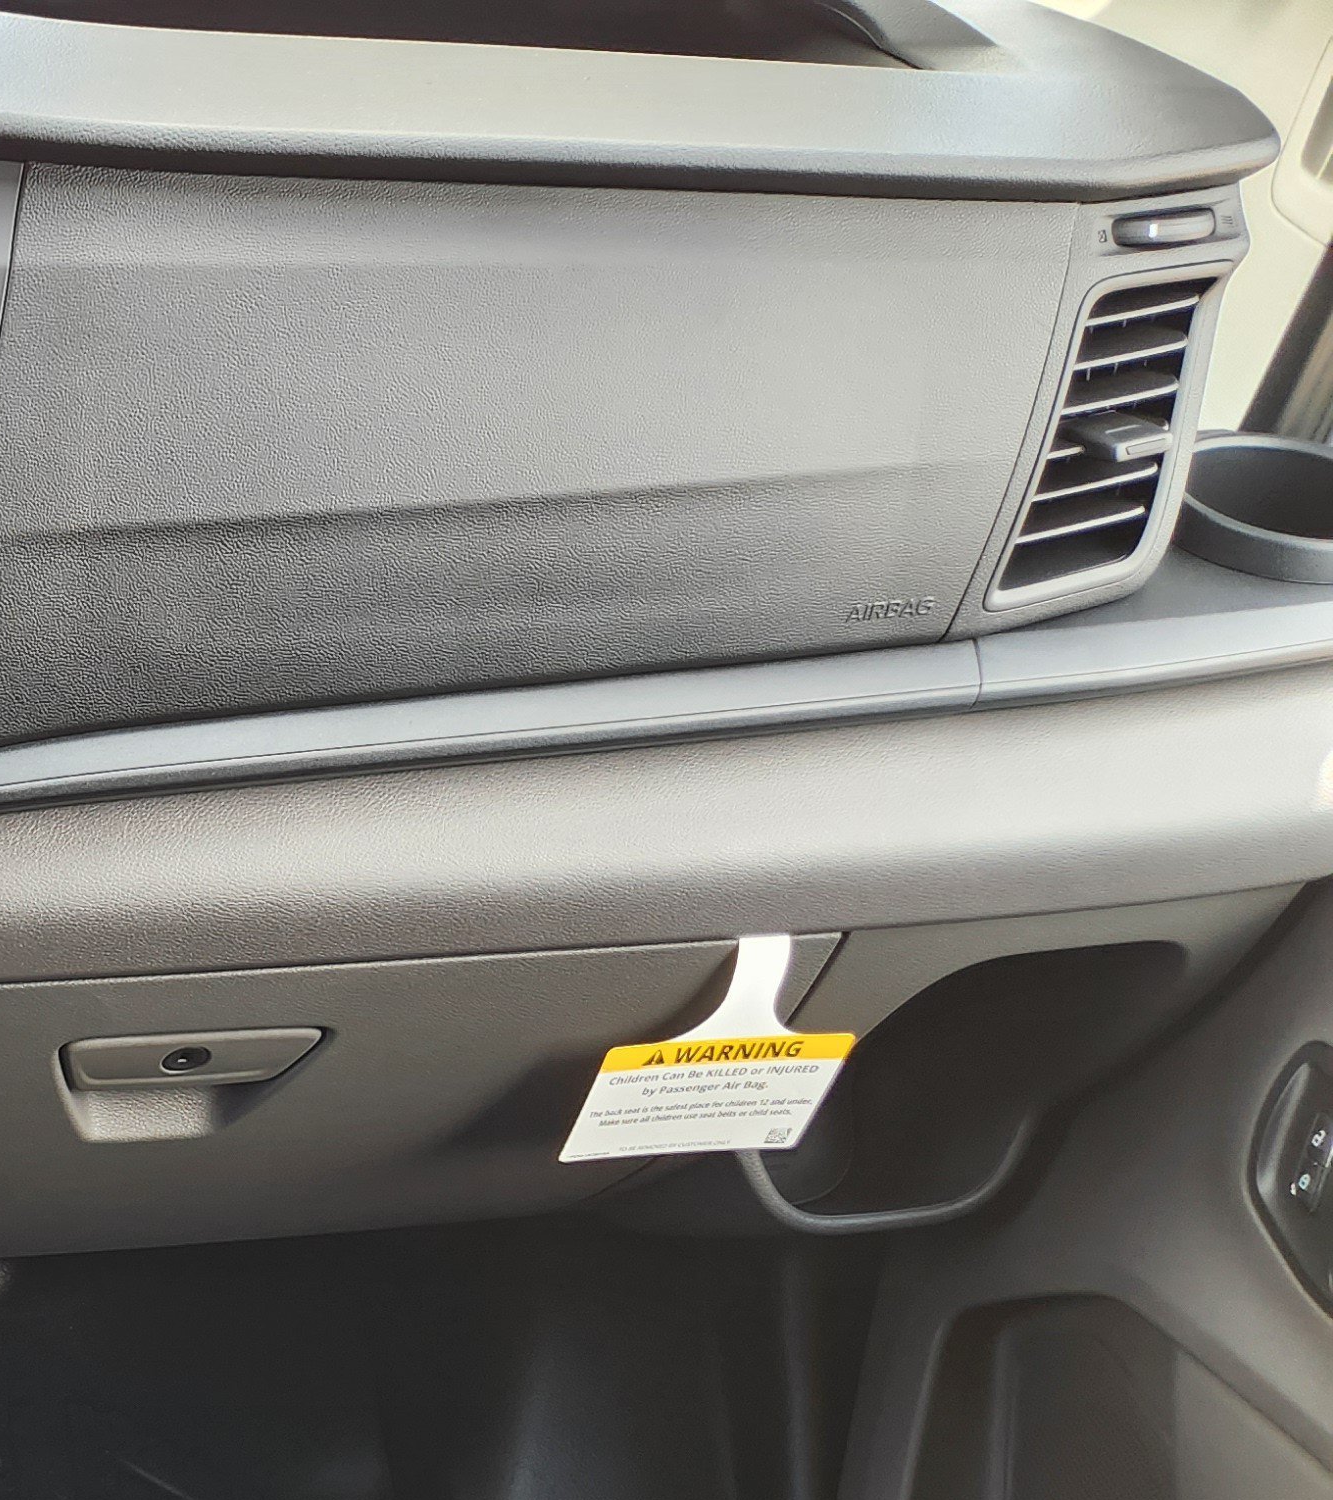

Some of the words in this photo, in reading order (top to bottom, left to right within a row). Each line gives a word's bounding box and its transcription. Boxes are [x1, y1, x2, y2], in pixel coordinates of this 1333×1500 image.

[845, 597, 935, 623] AIRBAG
[674, 1041, 804, 1063] WARNING
[609, 1073, 658, 1086] Children
[662, 1071, 684, 1081] Can
[688, 1070, 703, 1079] Be
[705, 1067, 747, 1078] KILLED
[750, 1067, 764, 1076] or
[766, 1065, 819, 1076] INJURED
[641, 1087, 657, 1097] by
[659, 1084, 721, 1094] Passenger
[722, 1081, 741, 1090] Air
